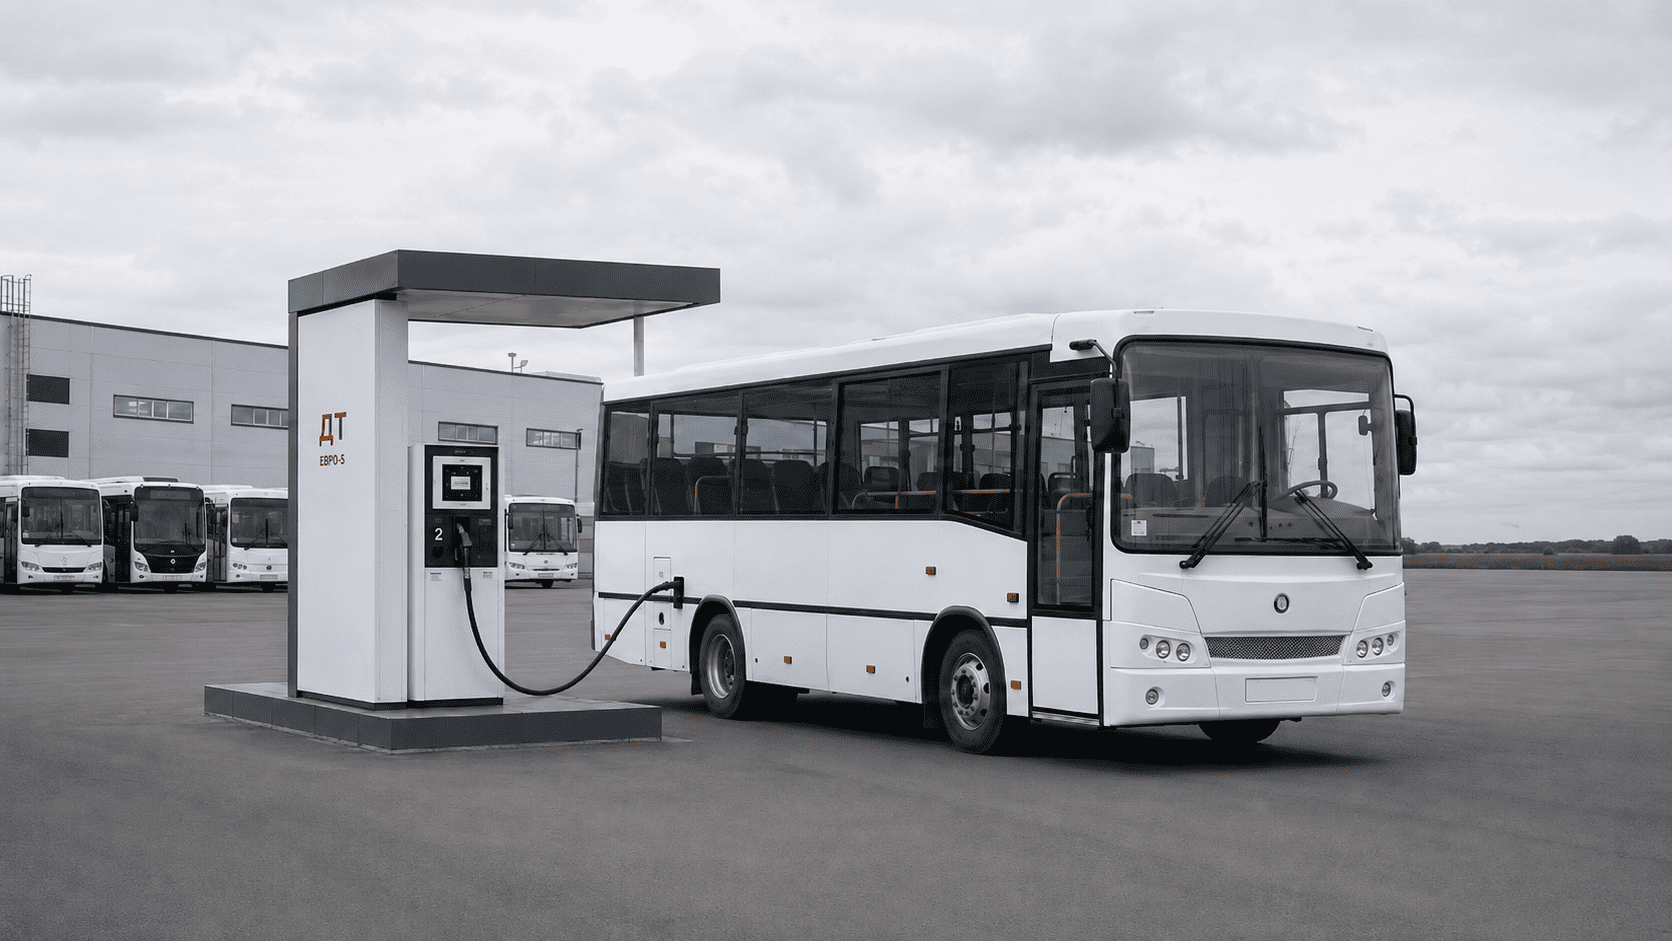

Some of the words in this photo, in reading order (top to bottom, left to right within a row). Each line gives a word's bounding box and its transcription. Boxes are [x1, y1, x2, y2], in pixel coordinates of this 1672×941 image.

[319, 411, 347, 447] ДТ
[319, 454, 346, 467] ЕВРО-5
[434, 527, 443, 541] 2
